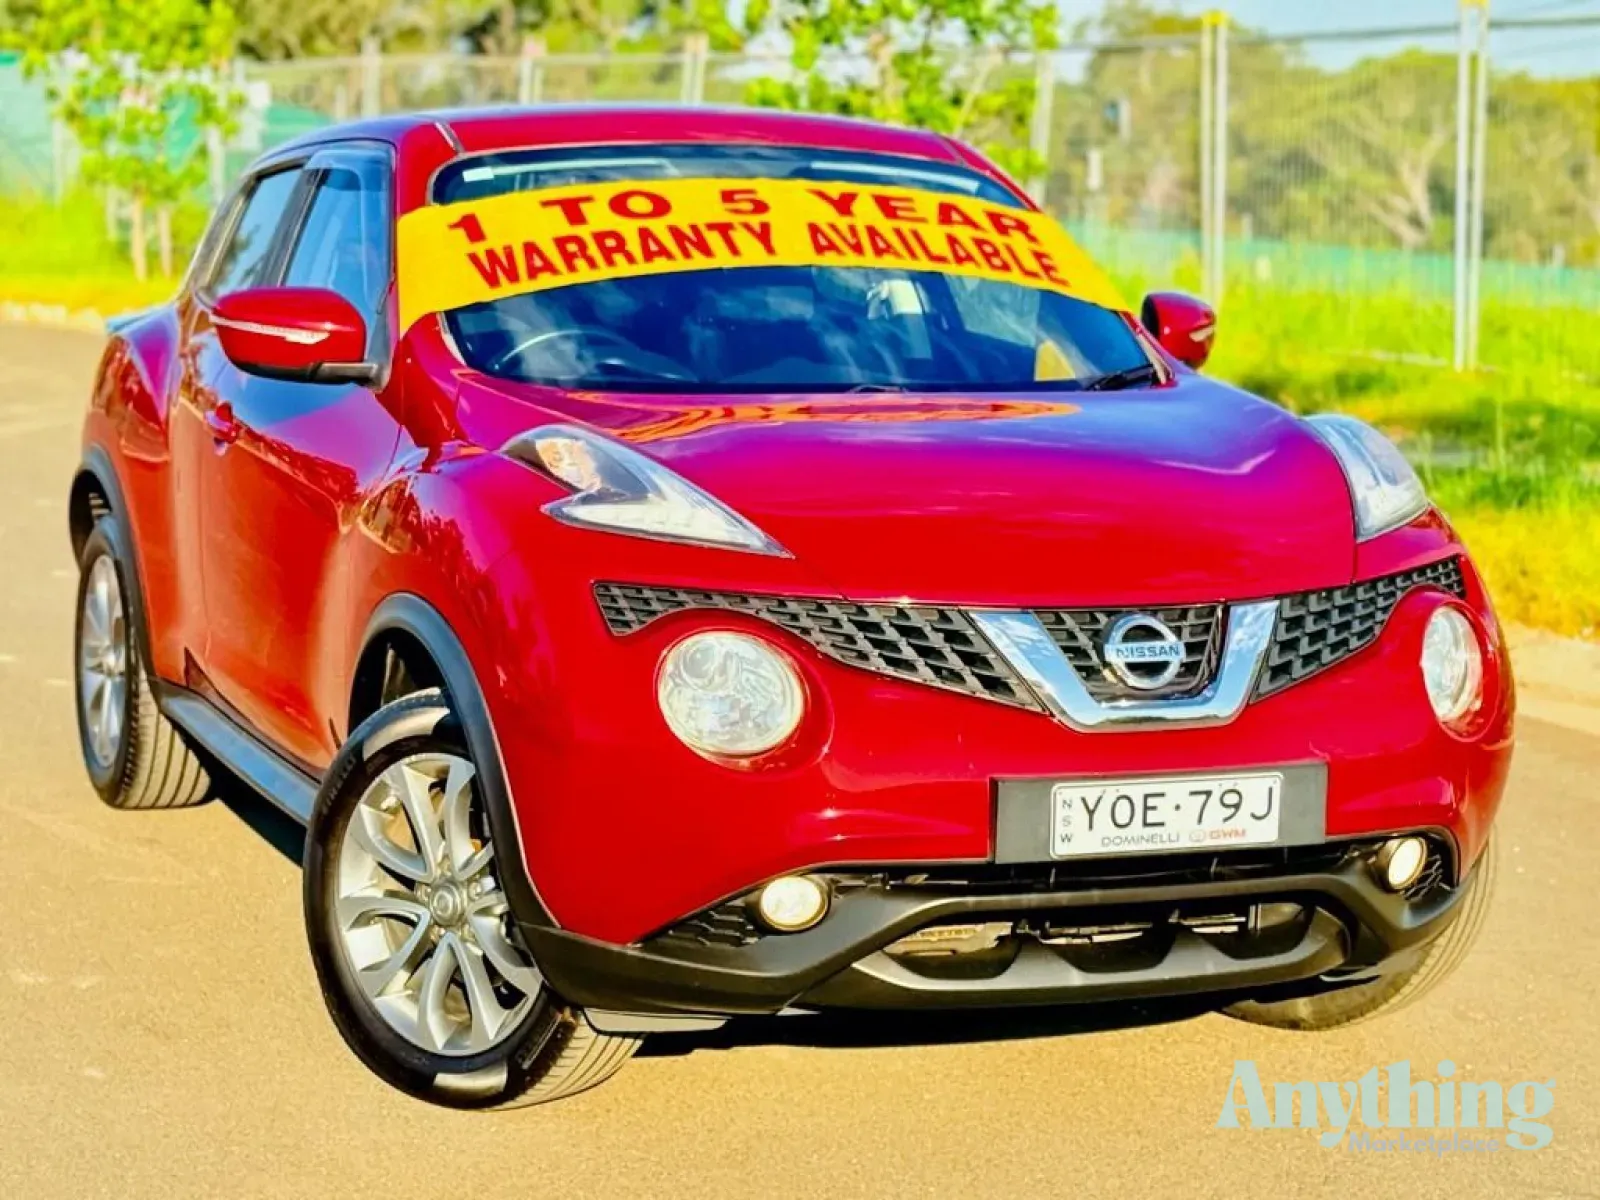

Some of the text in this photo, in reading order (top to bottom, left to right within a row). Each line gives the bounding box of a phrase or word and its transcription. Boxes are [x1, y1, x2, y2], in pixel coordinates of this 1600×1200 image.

[447, 189, 1038, 244] 1 TO 5 YEAR
[467, 221, 1070, 289] WARRANTY AVAILABLE
[1115, 645, 1180, 658] NISSAN
[1101, 828, 1246, 847] DOMINELLI GWM
